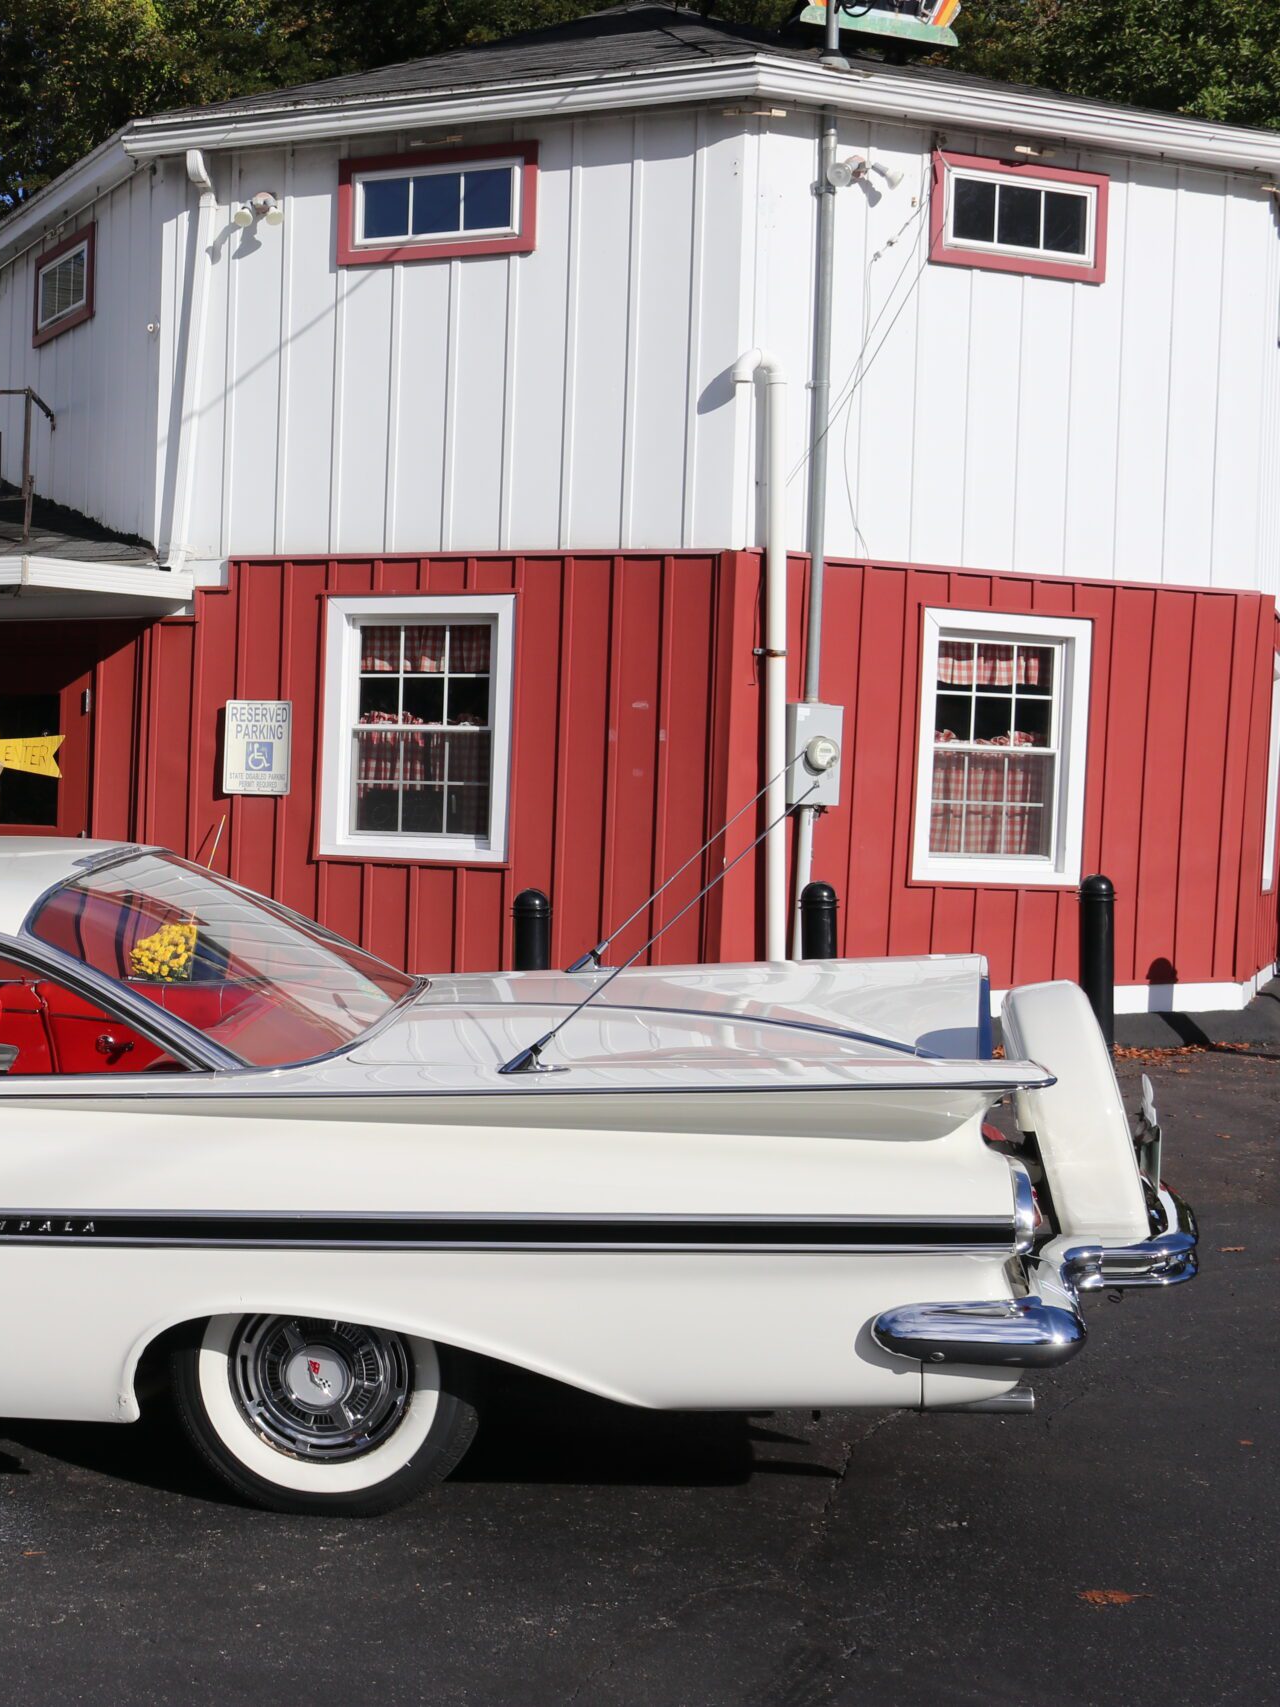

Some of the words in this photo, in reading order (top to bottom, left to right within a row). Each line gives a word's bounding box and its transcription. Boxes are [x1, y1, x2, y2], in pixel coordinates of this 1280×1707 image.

[231, 707, 288, 723] RESERVED
[235, 724, 283, 740] PARKING
[5, 745, 48, 767] ENTER
